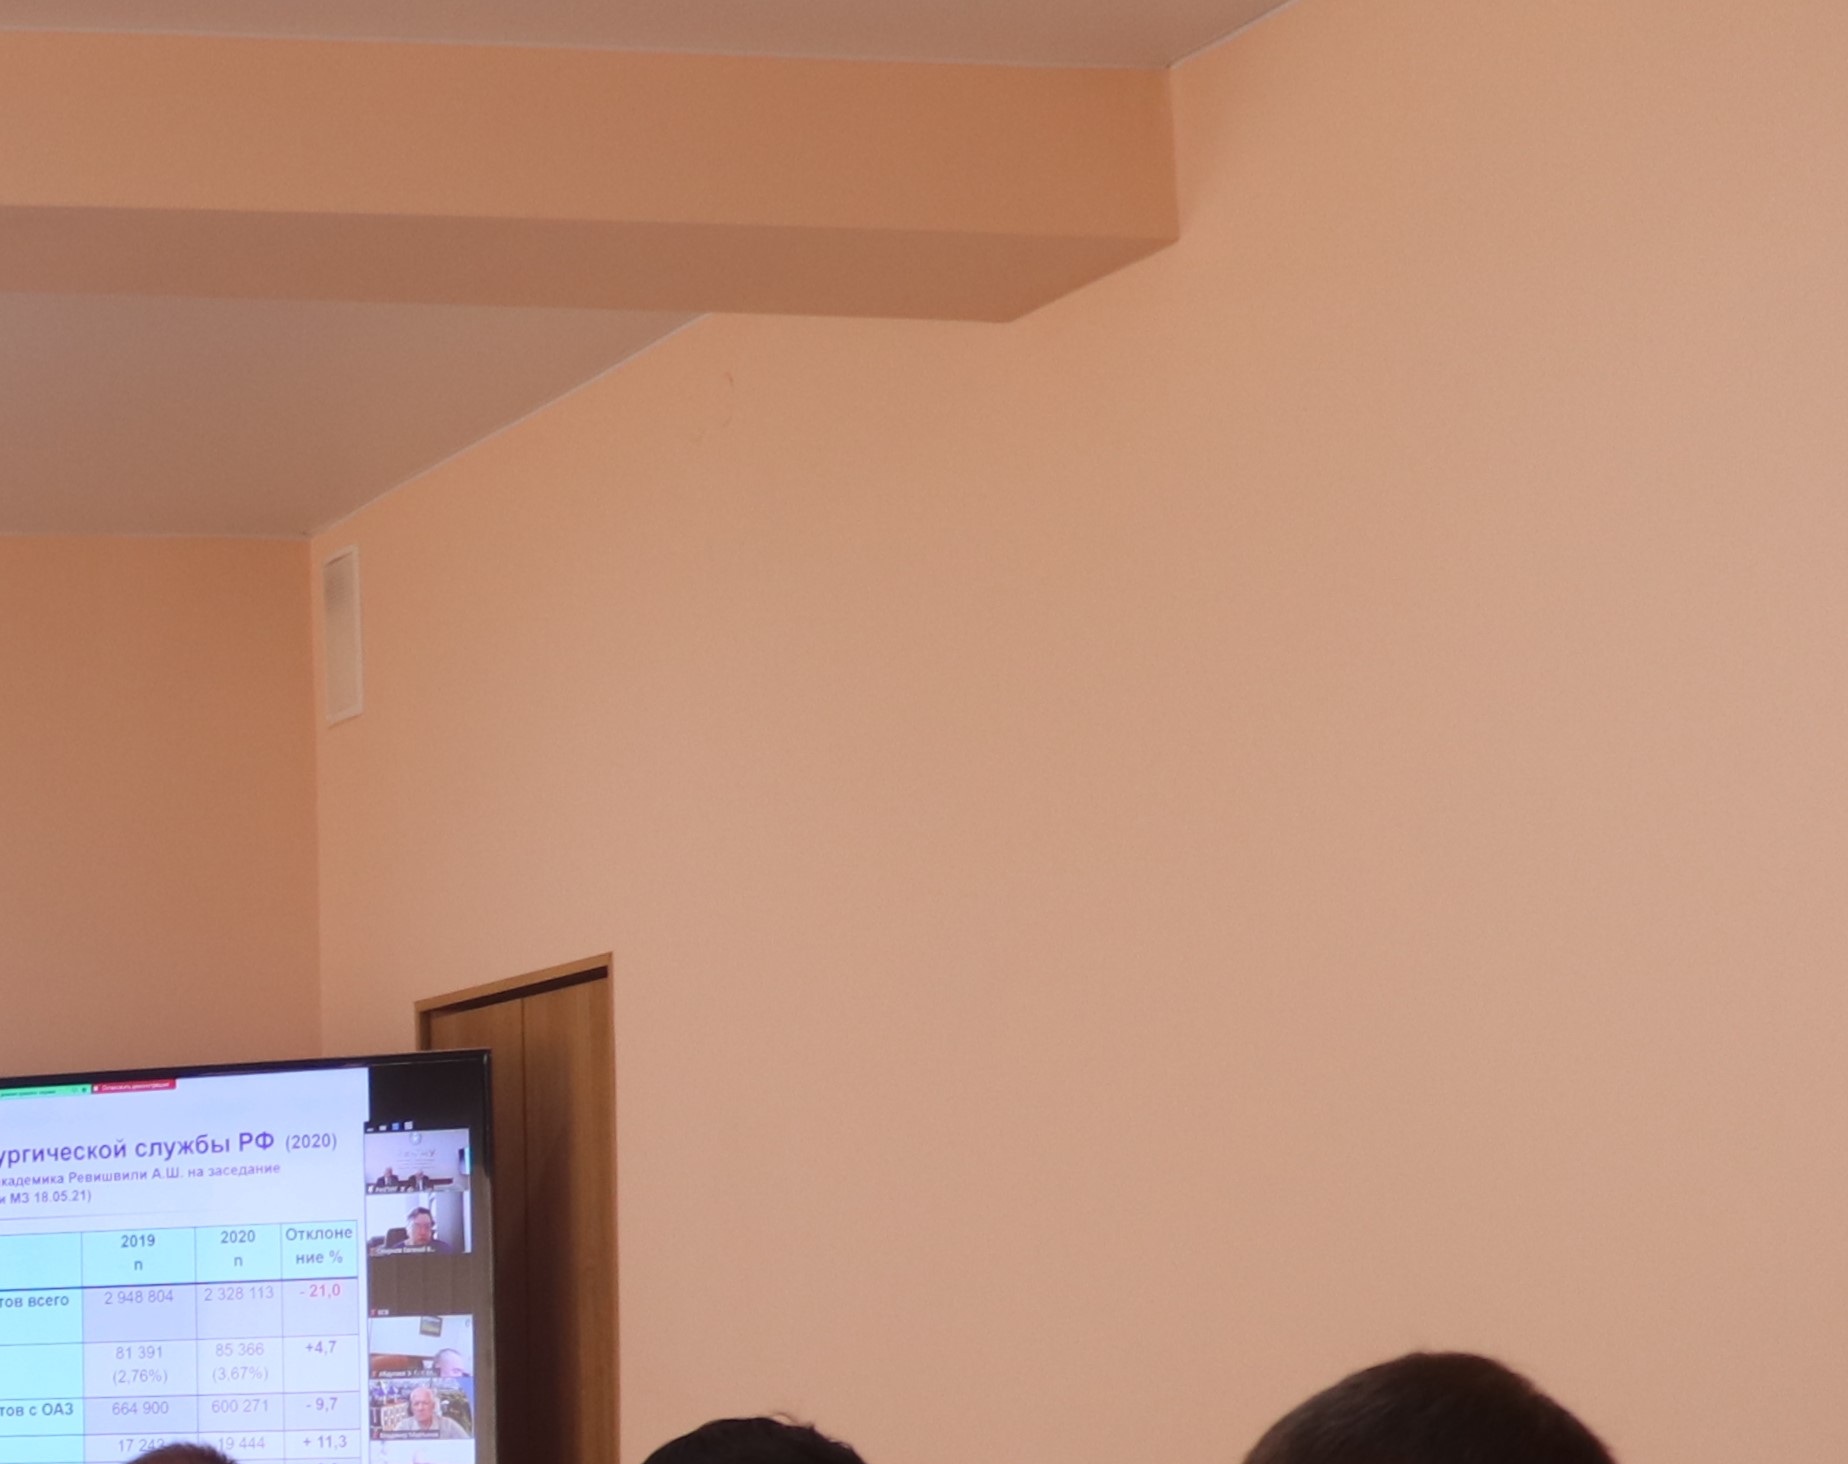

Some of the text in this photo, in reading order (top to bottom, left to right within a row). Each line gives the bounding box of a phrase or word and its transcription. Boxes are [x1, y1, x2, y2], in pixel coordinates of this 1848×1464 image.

[135, 1134, 230, 1162] службы
[238, 1131, 274, 1152] РФ
[285, 1132, 337, 1152] (2020)
[68, 1168, 148, 1184] Ревишвили
[152, 1166, 183, 1180] А.Ш.
[188, 1166, 204, 1178] на
[208, 1162, 280, 1177] заседание
[10, 1193, 29, 1204] МЗ
[34, 1188, 92, 1203] 18.05.21)
[121, 1234, 155, 1248] 2019
[220, 1229, 256, 1244] 2020
[285, 1227, 352, 1241] Отклоне
[296, 1250, 343, 1265] ние %
[104, 1289, 174, 1305] 2 948 804
[204, 1286, 274, 1301] 2 328 113
[309, 1284, 341, 1299] 21,0
[28, 1294, 70, 1308] всего
[115, 1346, 163, 1360] 81 391
[216, 1342, 264, 1357] 85 366
[305, 1340, 337, 1355] +4,7
[112, 1369, 168, 1385] (2,76%)
[212, 1366, 269, 1382] (3,67%)
[29, 1406, 37, 1416] с
[41, 1402, 74, 1416] ОАЗ
[112, 1401, 169, 1415] 664 900
[211, 1399, 268, 1413] 600 271
[315, 1397, 338, 1412] 9,7
[119, 1440, 132, 1452] 17
[218, 1436, 265, 1451] 19 444
[317, 1435, 347, 1450] 11,3
